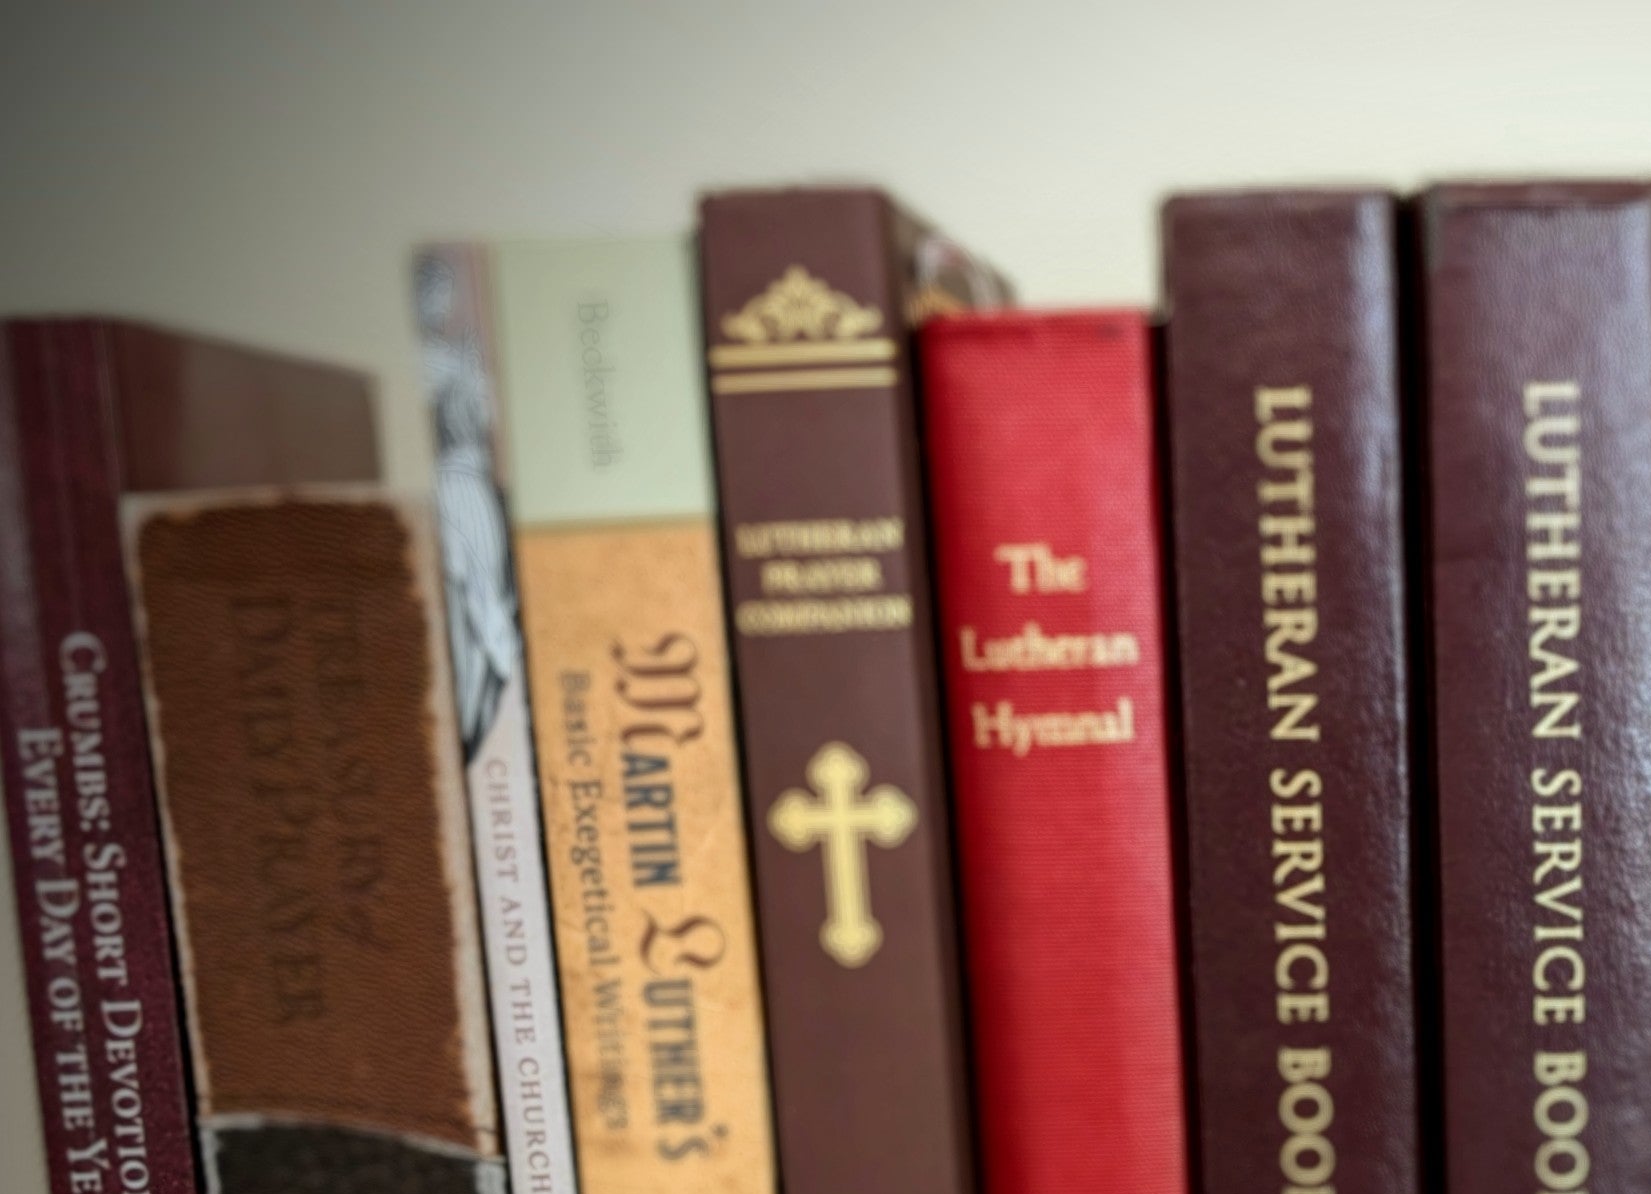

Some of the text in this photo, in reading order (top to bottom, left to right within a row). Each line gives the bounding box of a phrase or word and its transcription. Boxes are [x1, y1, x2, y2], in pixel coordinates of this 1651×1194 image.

[578, 298, 625, 472] Beckwith
[994, 541, 1086, 595] The
[1254, 383, 1321, 742] LUTHERAN
[1523, 380, 1582, 739] LUTHERAN
[560, 671, 598, 767] Basic
[960, 619, 1141, 672] Lutheran
[17, 727, 66, 864] EVERY
[59, 630, 110, 831] CRUMBS:
[610, 632, 704, 888] MARTIN
[972, 696, 1134, 757] Hymnal
[34, 878, 81, 964] DAY
[84, 843, 128, 986] SHORT
[569, 780, 620, 967] Exegetical
[1269, 767, 1330, 1026] SERVICE
[1531, 767, 1586, 1026] SERVICE
[48, 977, 83, 1031] OF
[485, 758, 553, 1194] CHRIST AND THE CHURCH
[56, 1043, 96, 1131] THE
